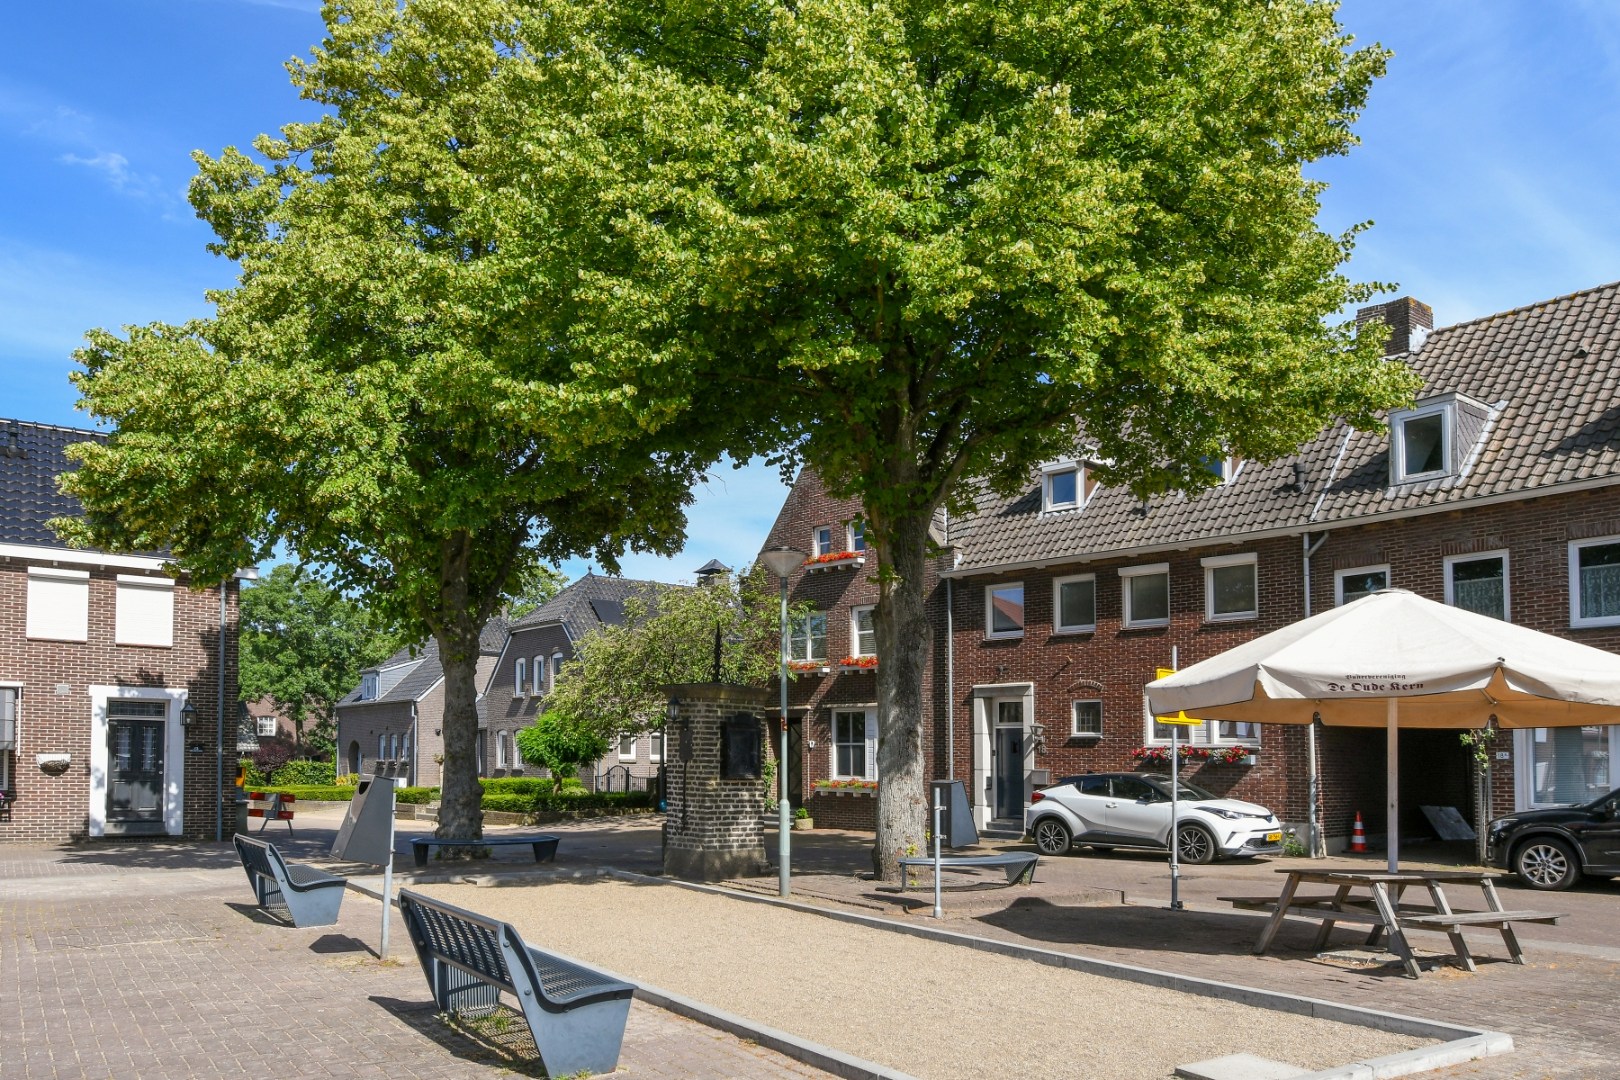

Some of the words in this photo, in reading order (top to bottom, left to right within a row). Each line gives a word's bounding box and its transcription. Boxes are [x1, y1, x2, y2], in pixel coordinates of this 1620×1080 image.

[1327, 682, 1345, 692] De
[1351, 682, 1385, 692] Oude
[1390, 681, 1424, 691] Kern
